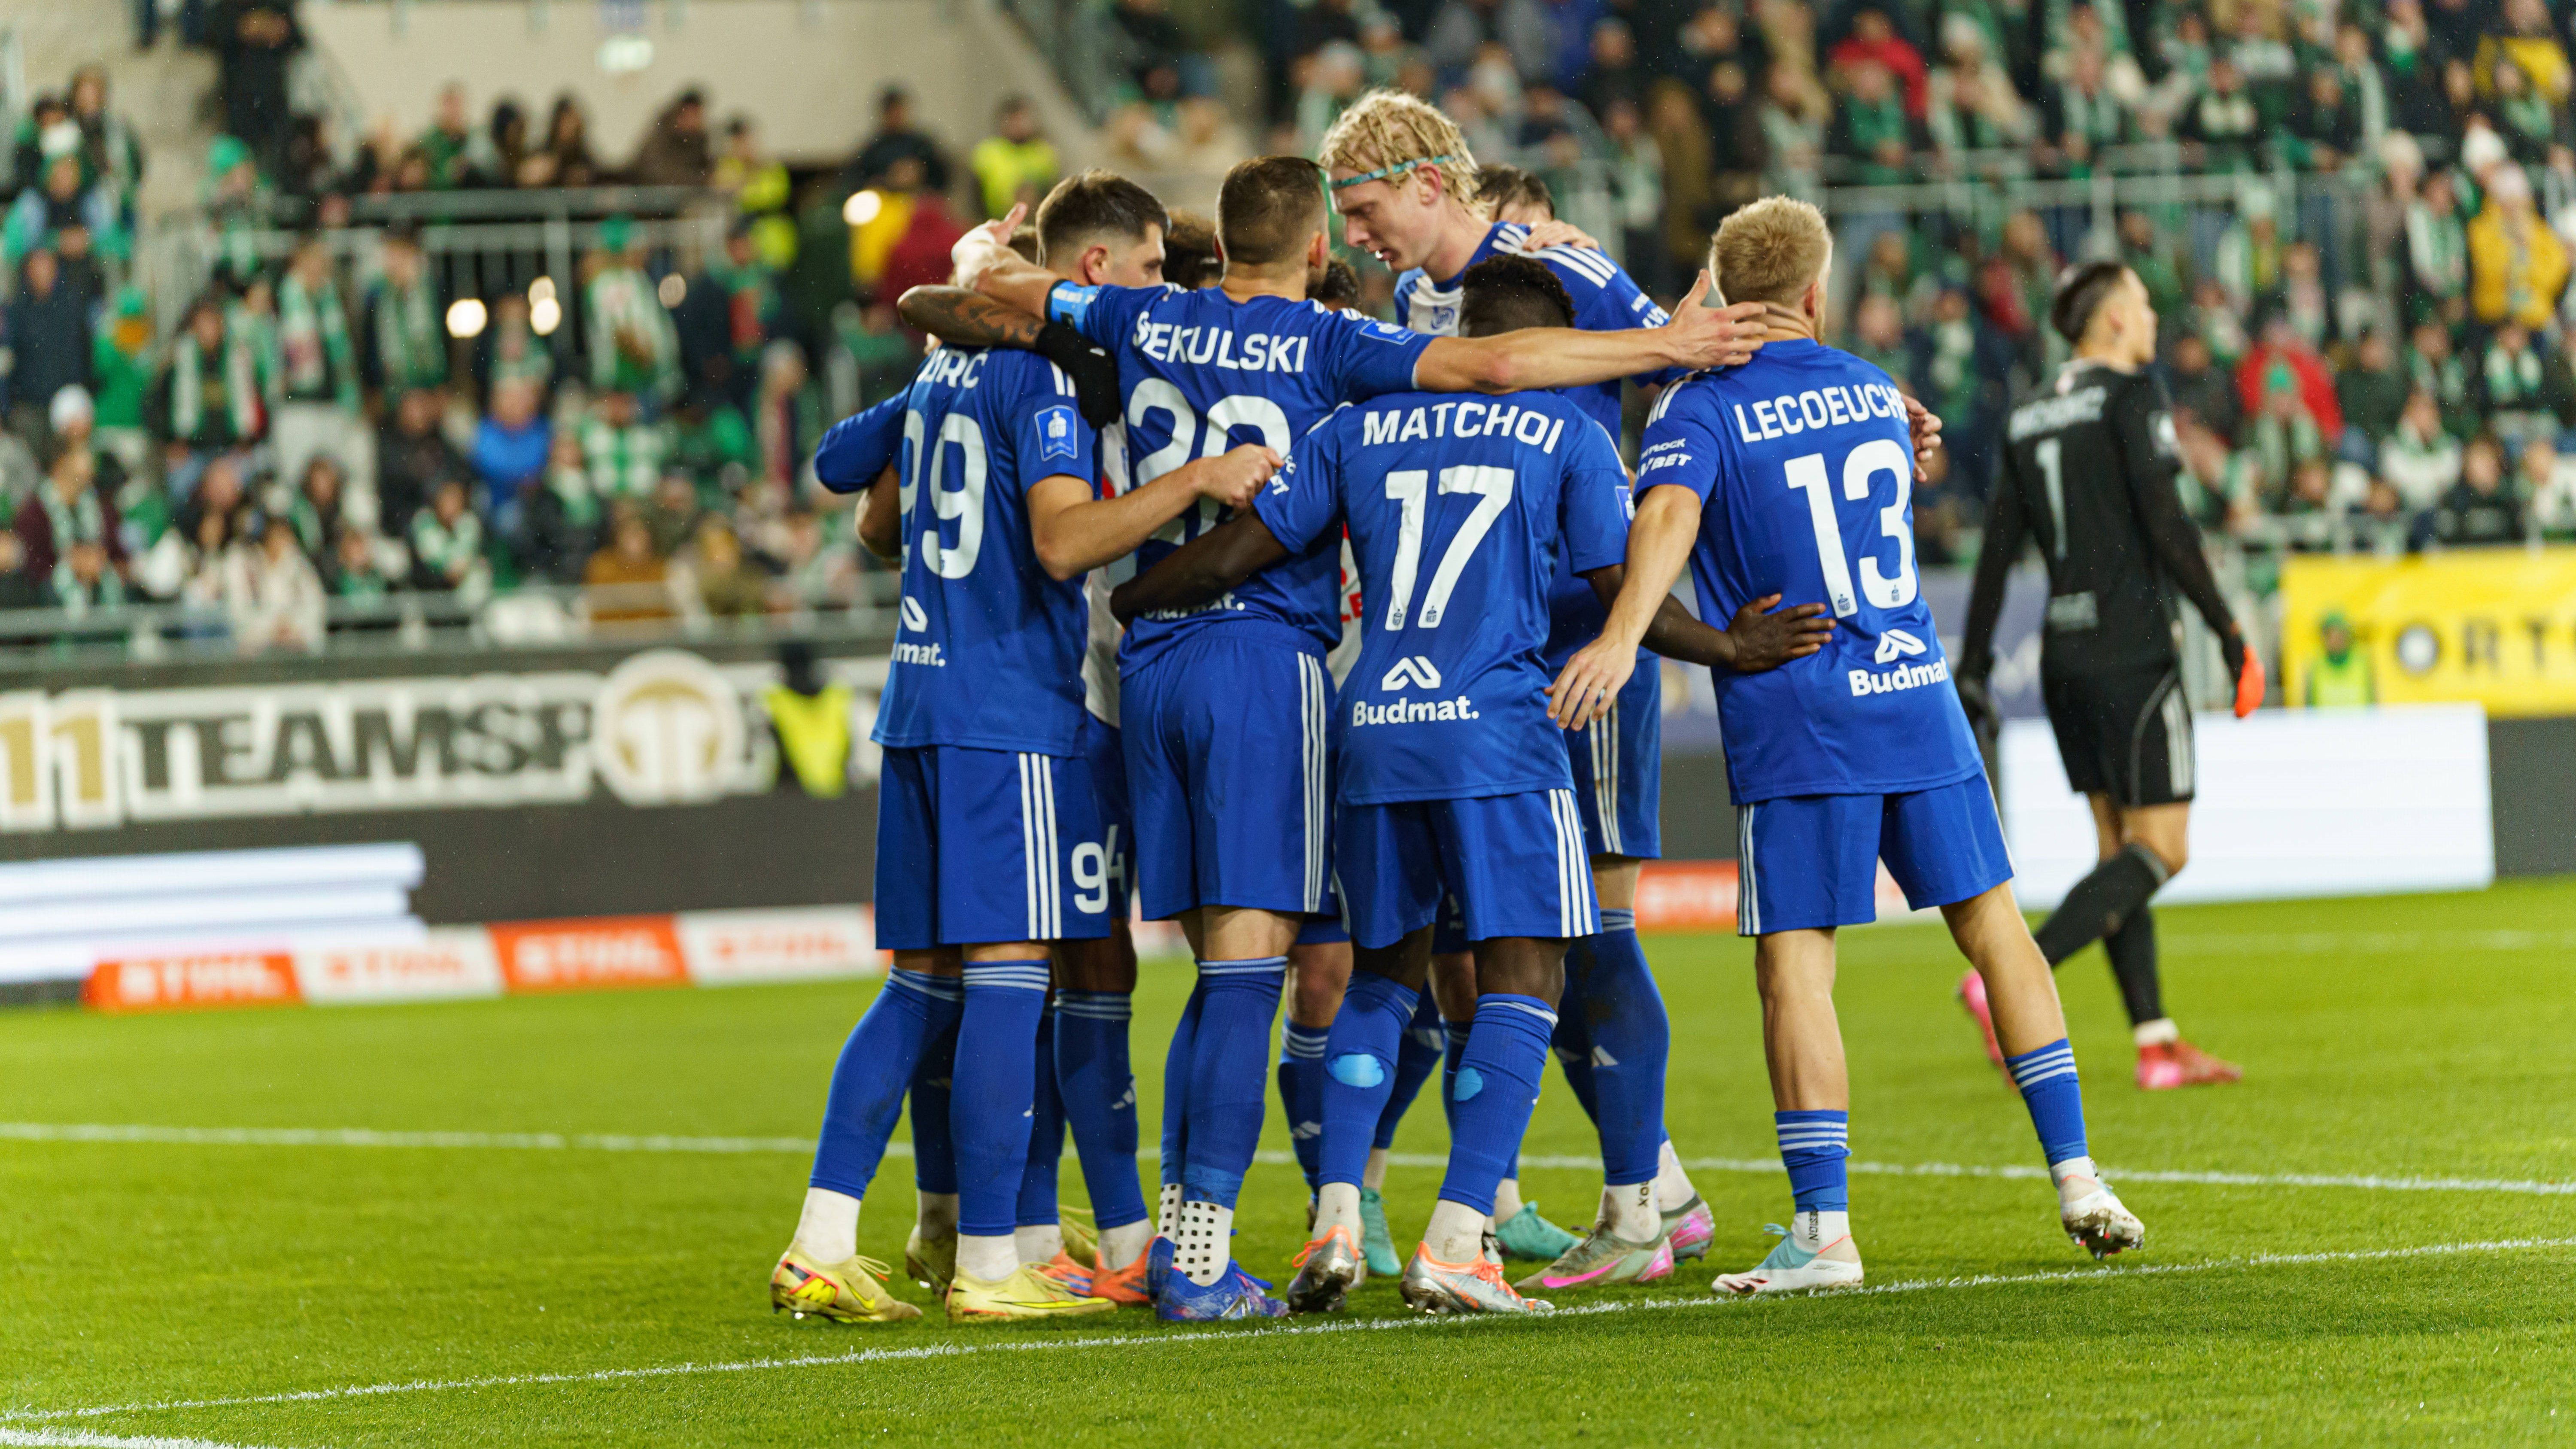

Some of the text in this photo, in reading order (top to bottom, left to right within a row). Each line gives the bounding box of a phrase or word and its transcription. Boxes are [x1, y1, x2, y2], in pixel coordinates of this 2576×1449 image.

[1133, 311, 1309, 373] SEKULSKI
[899, 409, 987, 579] 99
[1128, 377, 1291, 545] 20
[1363, 402, 1564, 454] MATCHOI
[2034, 436, 2069, 559] 1
[1385, 465, 1515, 631] 17
[1784, 439, 1917, 618] 13
[1353, 696, 1479, 726] Budmat.
